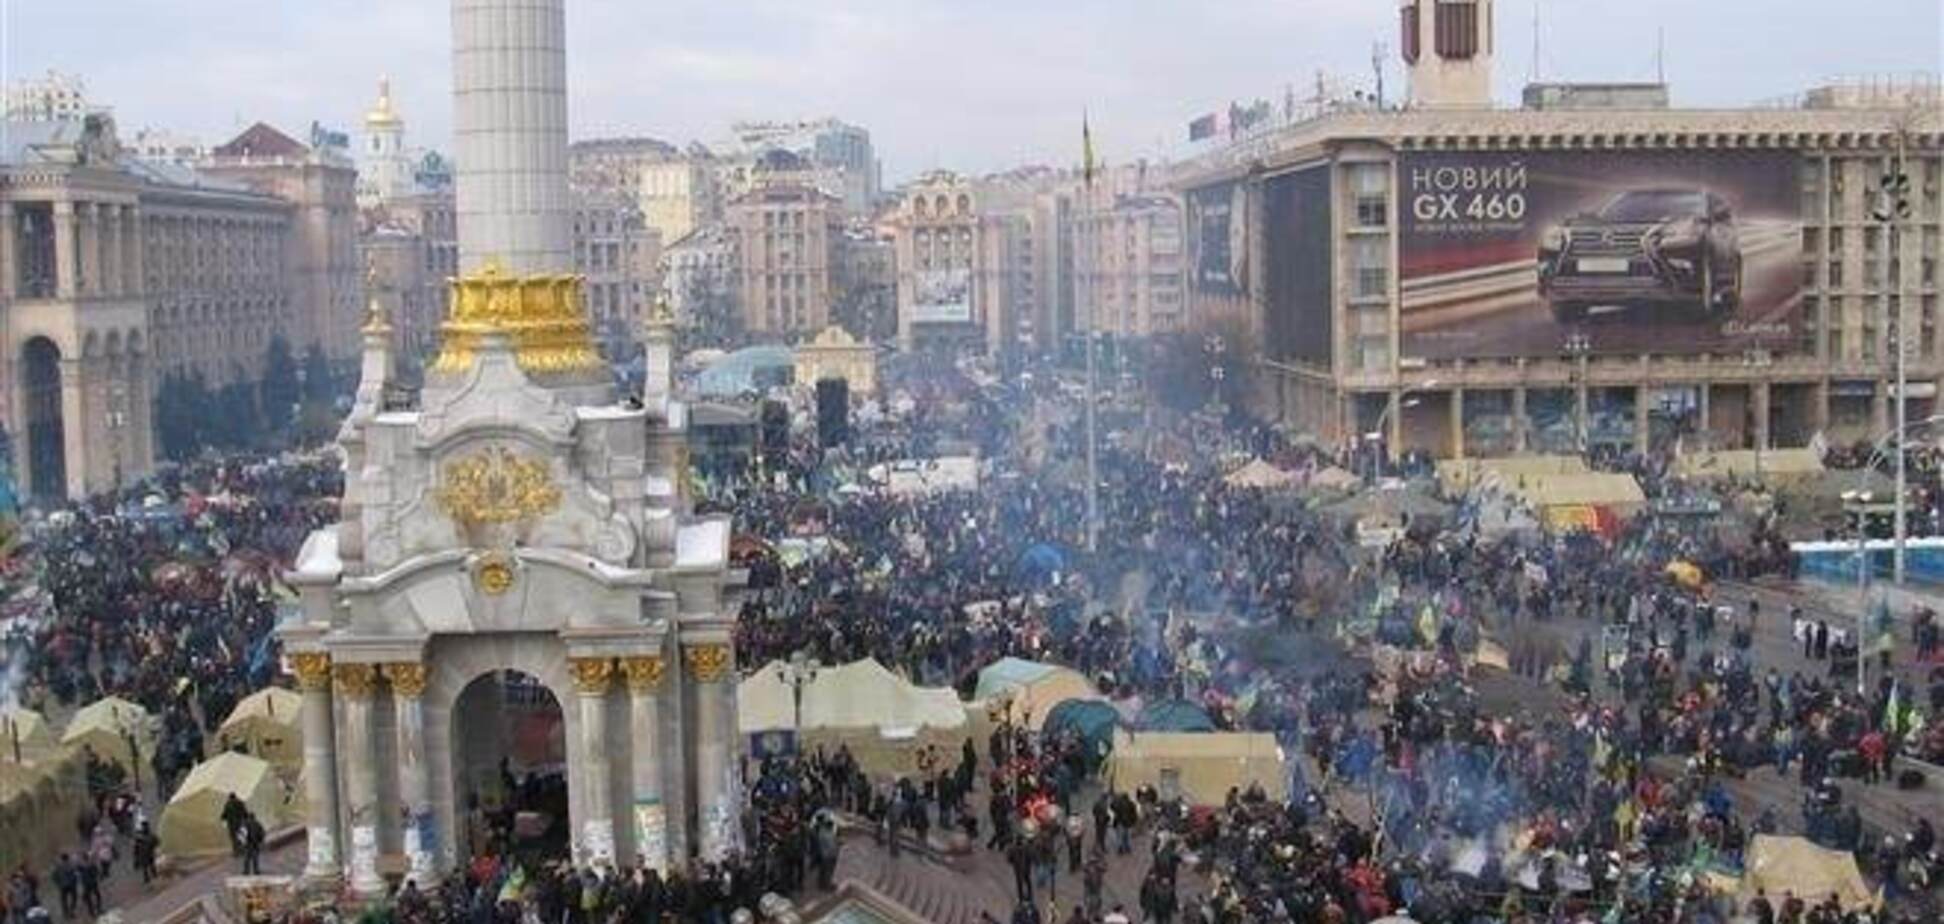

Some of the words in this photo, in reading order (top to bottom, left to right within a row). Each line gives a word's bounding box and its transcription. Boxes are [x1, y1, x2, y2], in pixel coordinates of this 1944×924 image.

[1412, 161, 1527, 191] НОВИЙ
[1413, 193, 1459, 219] GX
[1466, 193, 1526, 219] 460
